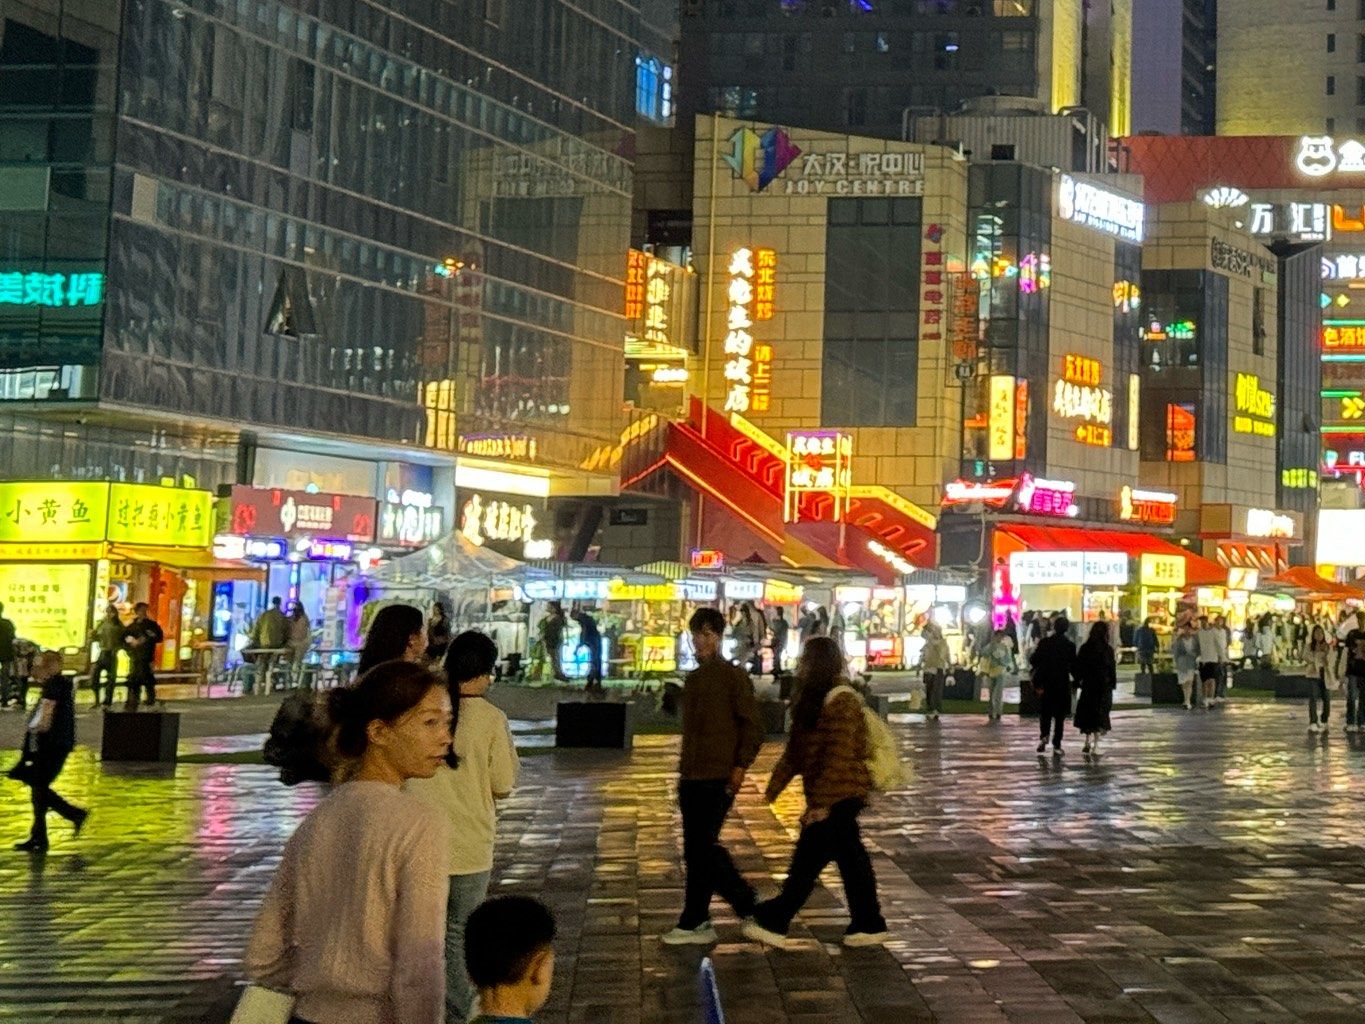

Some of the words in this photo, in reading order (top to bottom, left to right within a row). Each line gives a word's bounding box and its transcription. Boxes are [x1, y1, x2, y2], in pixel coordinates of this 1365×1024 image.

[786, 179, 826, 195] JOY
[836, 179, 925, 195] CENTRE
[6, 499, 91, 525] 小黄鱼
